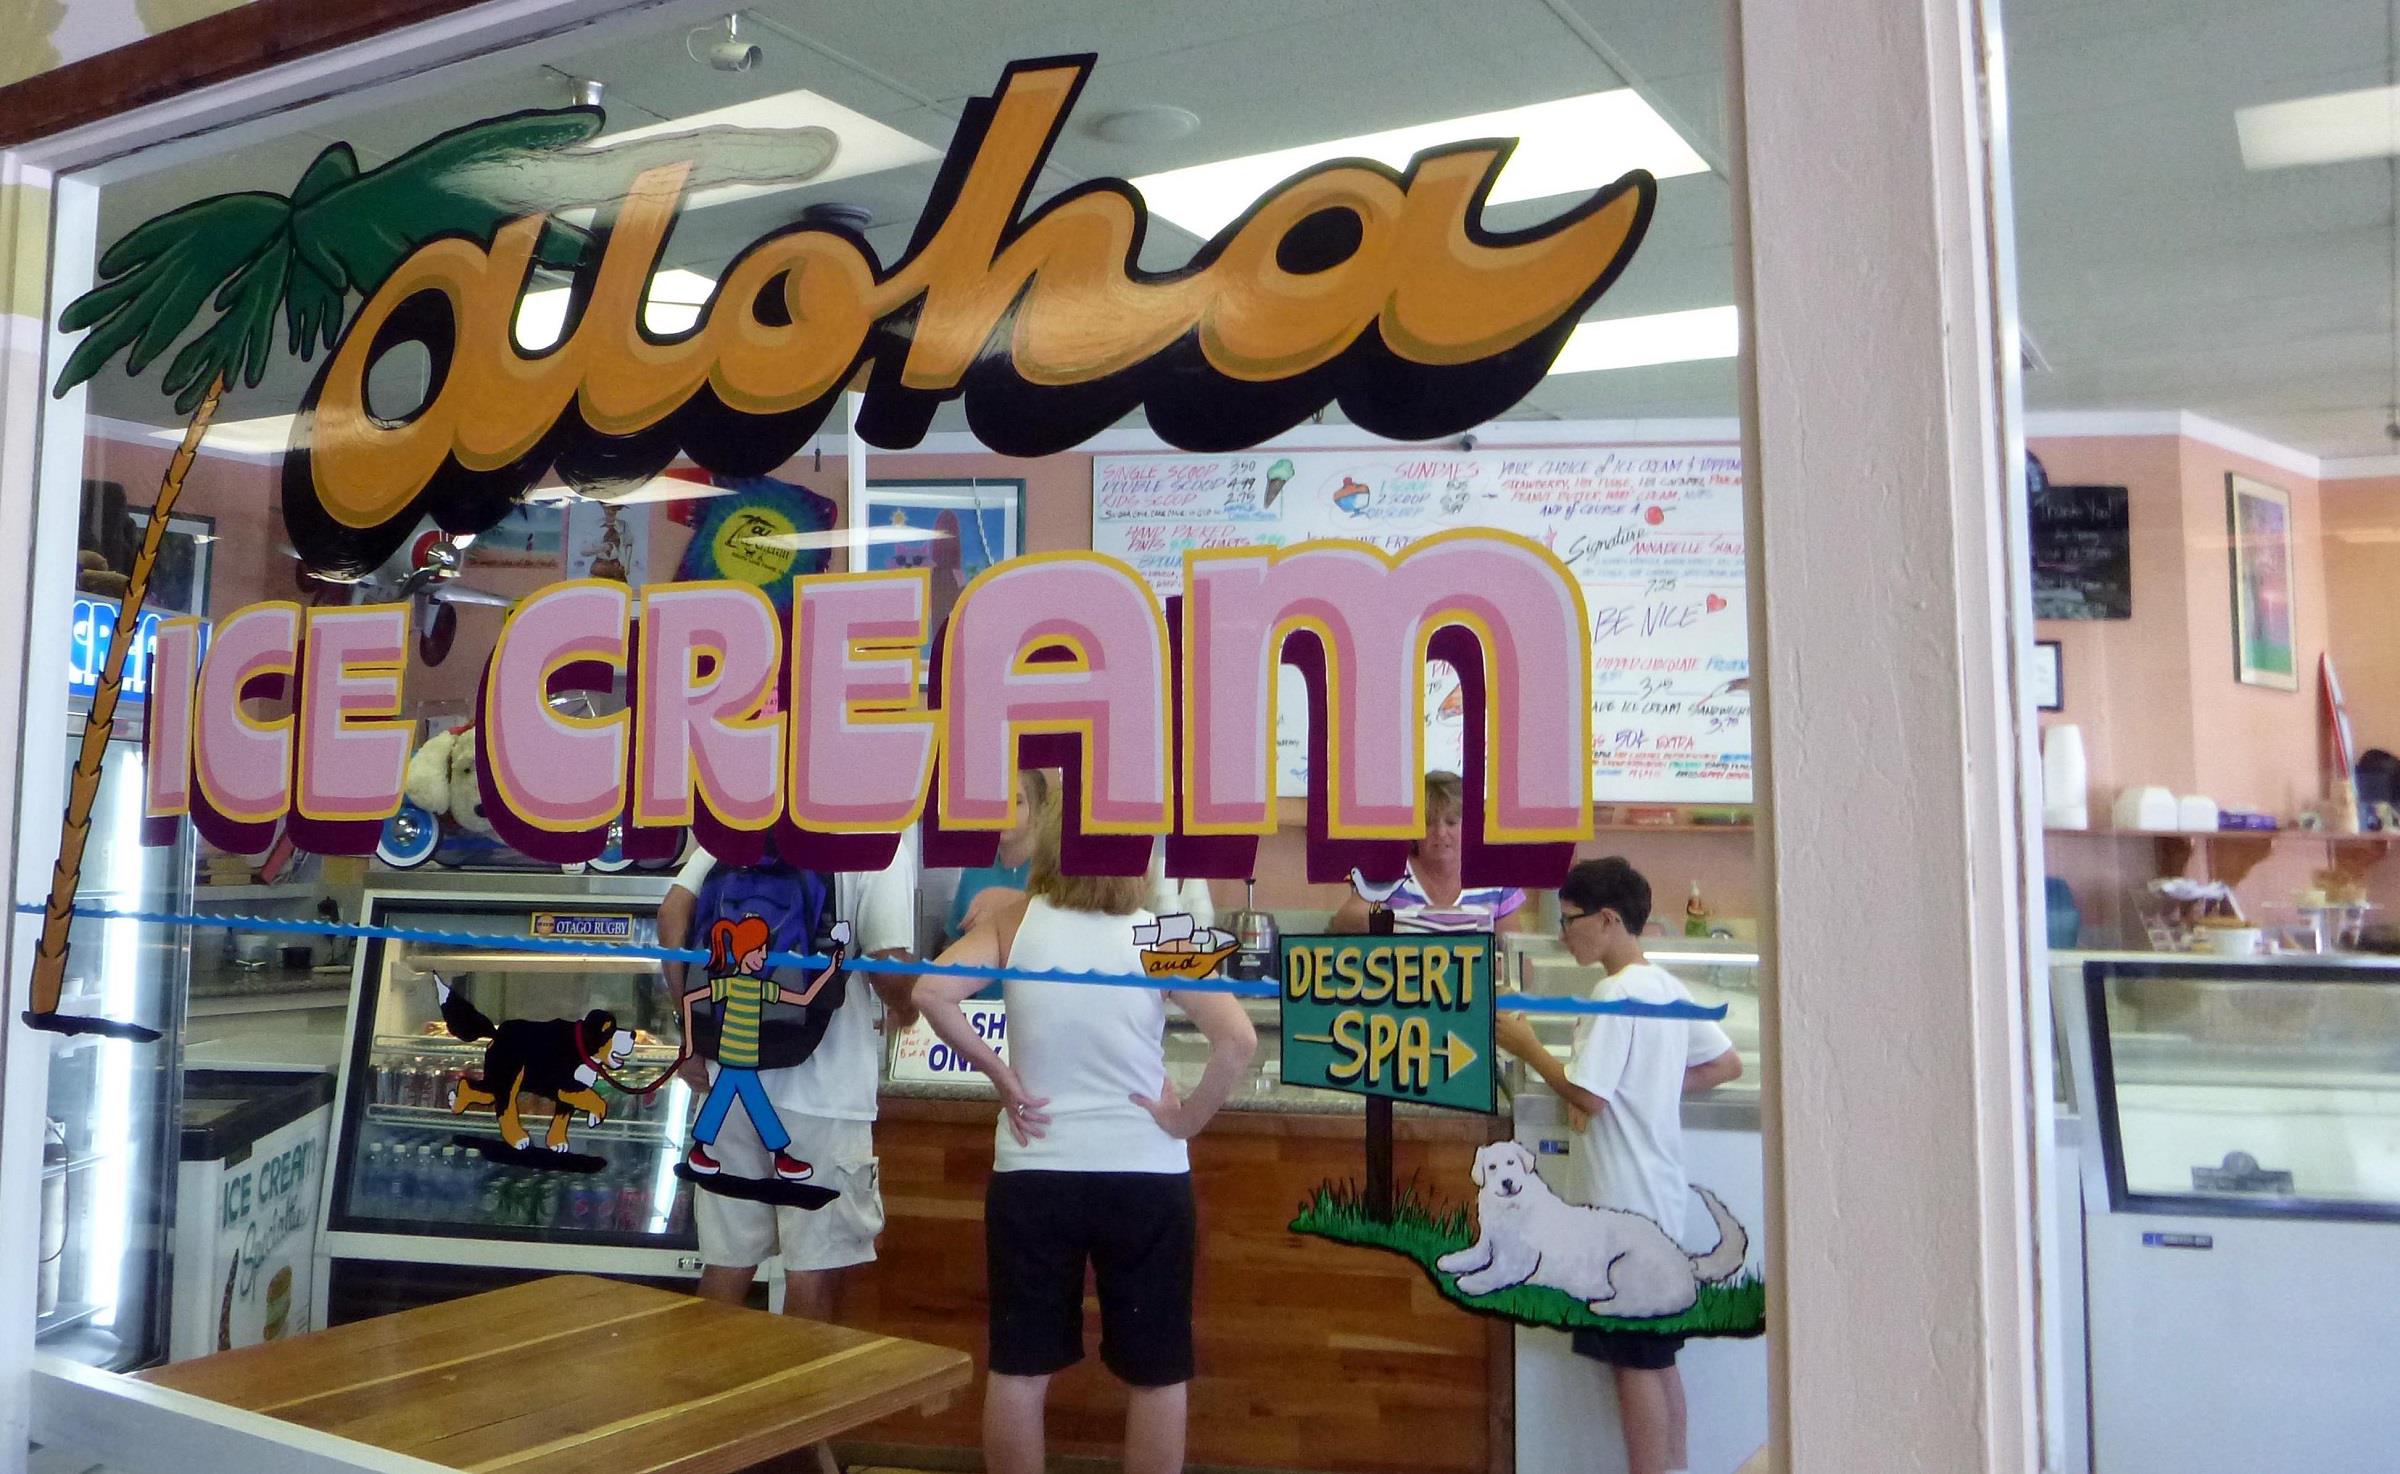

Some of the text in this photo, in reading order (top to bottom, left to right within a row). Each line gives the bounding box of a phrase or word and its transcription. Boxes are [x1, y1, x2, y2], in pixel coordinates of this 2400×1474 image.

[1103, 464, 1158, 480] SINGLE
[1168, 463, 1220, 480] SCOOP
[1395, 461, 1480, 481] SUNDAES
[1638, 457, 1683, 473] CREAM
[1170, 478, 1226, 492] SCOOP
[1593, 599, 1703, 644] BE NICE
[143, 528, 1594, 885] ICE CREAM
[1655, 734, 1695, 750] EXTRA
[556, 920, 592, 935] OTAGO
[593, 920, 628, 936] RUGBY
[1287, 944, 1484, 1011] DESSERT
[928, 1043, 1003, 1073] ON
[1326, 1009, 1431, 1096] SPA
[222, 1137, 316, 1230] ICE CREAM
